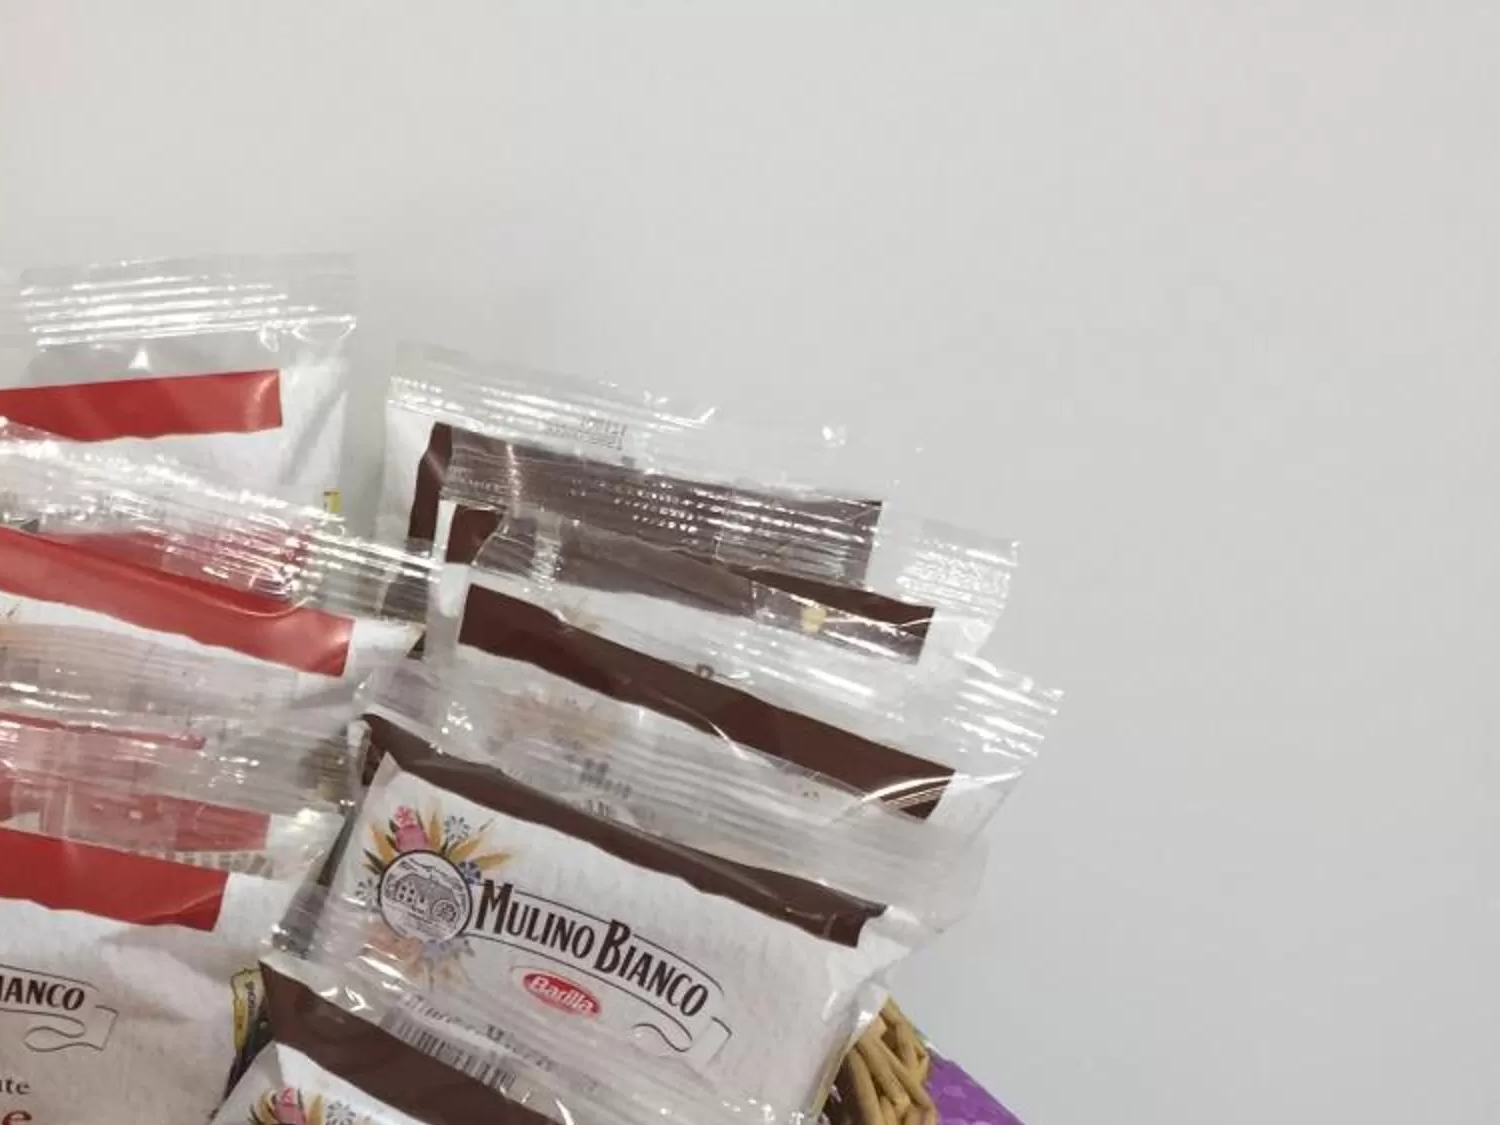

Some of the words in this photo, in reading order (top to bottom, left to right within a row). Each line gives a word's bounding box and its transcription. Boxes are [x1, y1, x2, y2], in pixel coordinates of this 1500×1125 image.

[475, 879, 595, 959] MULINO
[594, 918, 709, 1017] BIANCO
[530, 975, 595, 1015] Barilla
